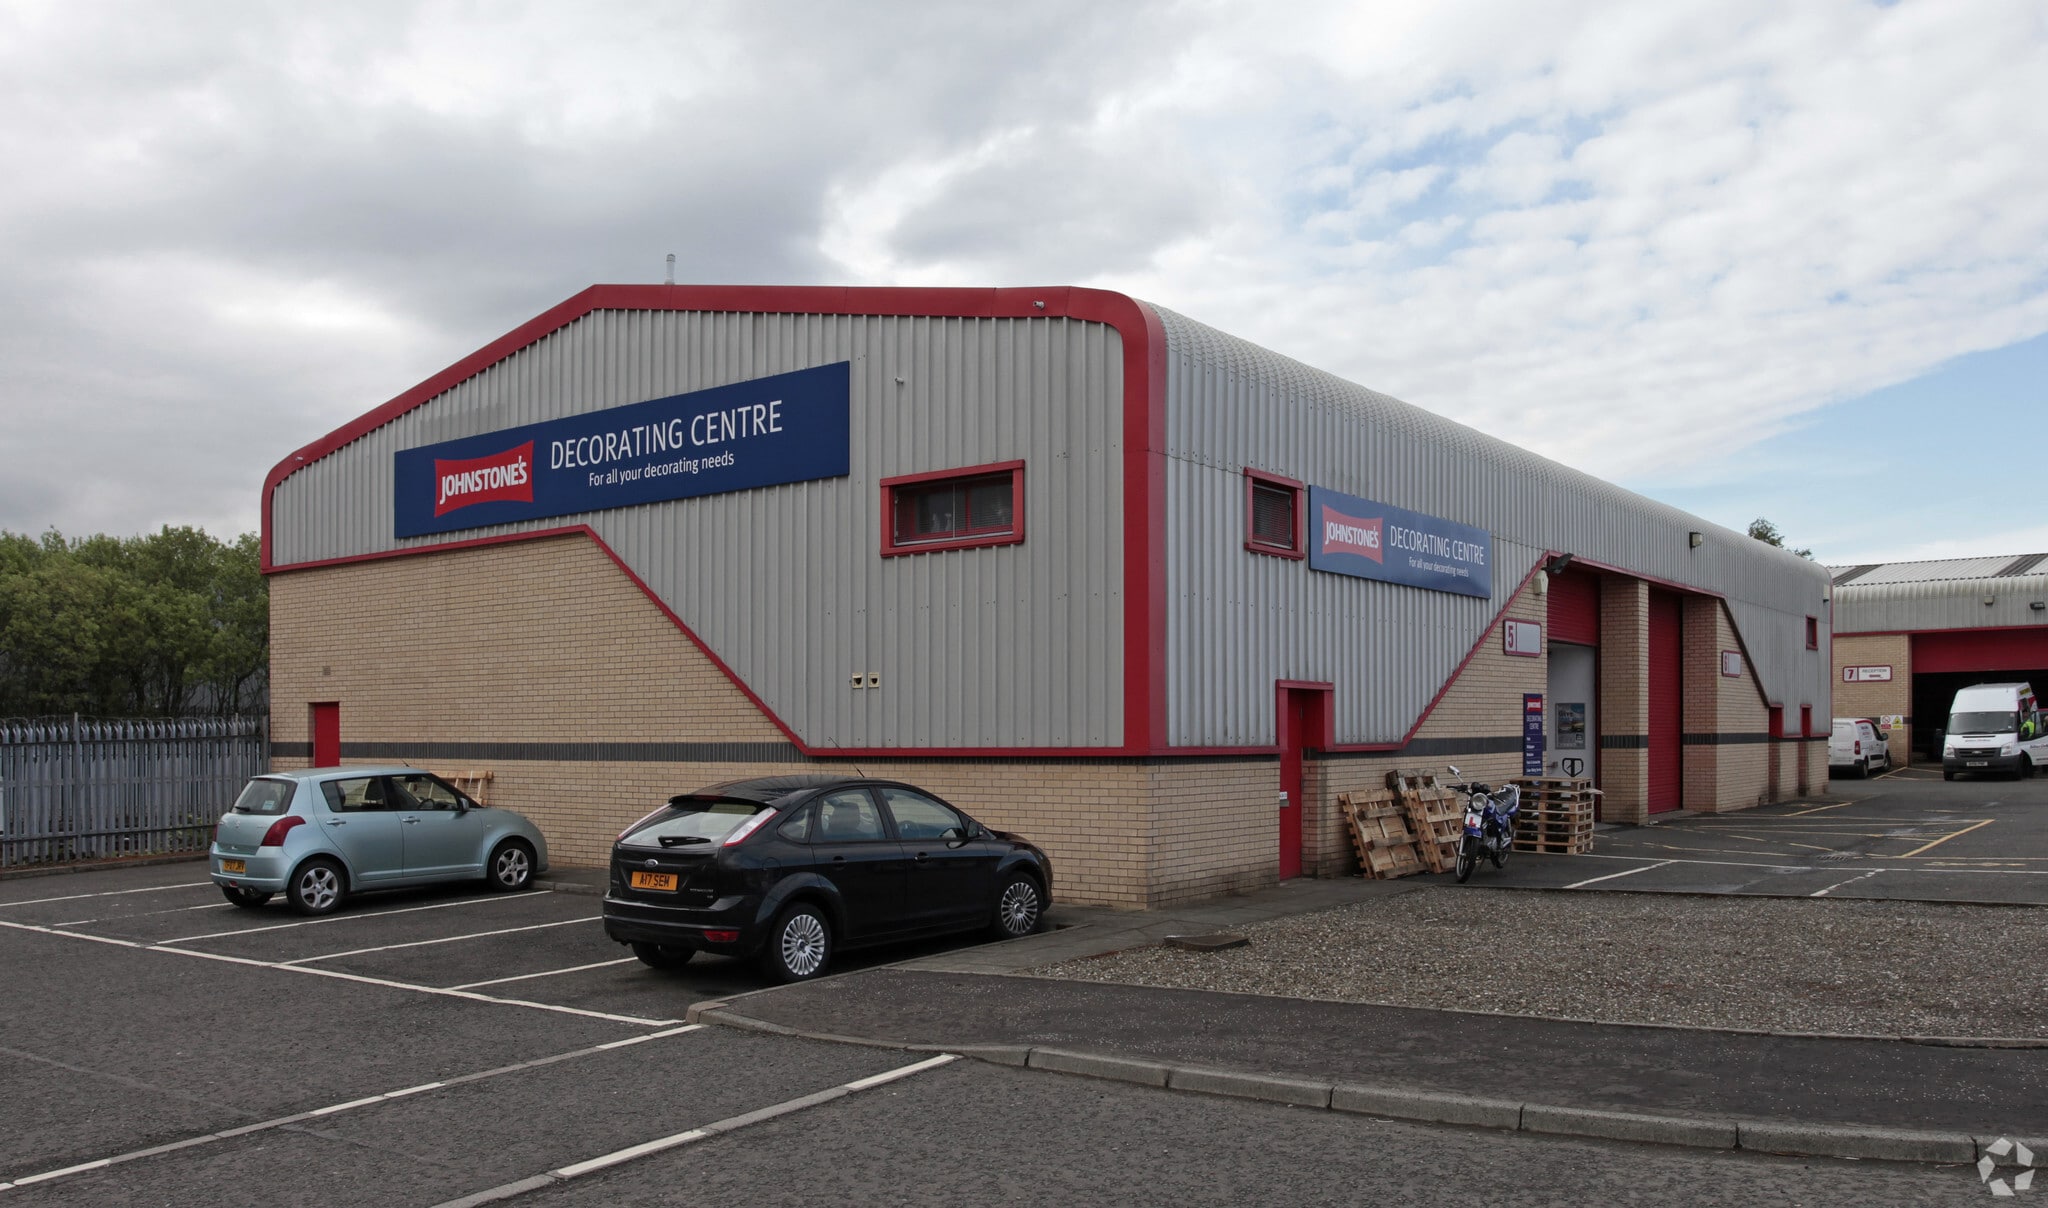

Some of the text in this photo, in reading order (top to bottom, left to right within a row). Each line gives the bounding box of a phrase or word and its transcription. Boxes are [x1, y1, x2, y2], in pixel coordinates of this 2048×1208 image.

[551, 400, 783, 470] DECORATING CENTRE
[440, 456, 527, 505] JOHNSTONE'S
[589, 450, 735, 487] For all your decorating needs
[1325, 521, 1379, 549] JOHNSTONE'S
[1390, 525, 1485, 565] DECORATING CENTRE
[1409, 556, 1417, 568] For
[1423, 561, 1434, 572] your
[1434, 562, 1457, 577] decorating
[1457, 566, 1469, 577] needs
[1508, 625, 1514, 649] 5
[1847, 669, 1855, 680] 7
[1469, 816, 1477, 828] L
